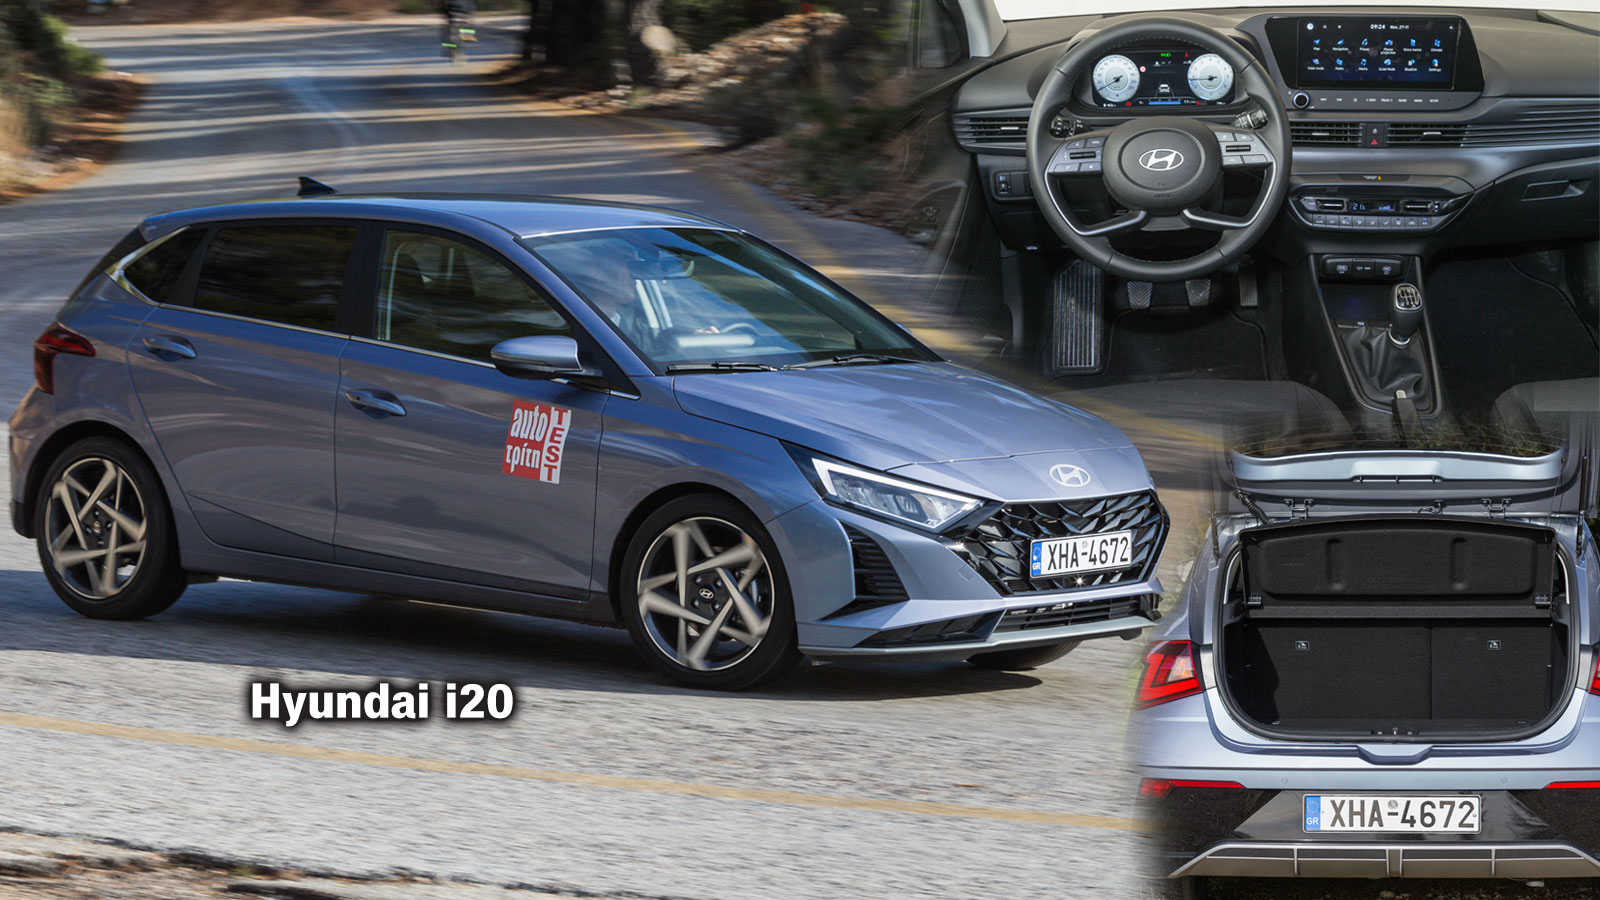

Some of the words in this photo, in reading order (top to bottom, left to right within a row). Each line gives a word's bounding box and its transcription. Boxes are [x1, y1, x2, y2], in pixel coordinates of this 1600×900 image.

[510, 405, 549, 442] auto
[543, 408, 568, 482] TEST
[1032, 562, 1041, 570] GR
[1048, 537, 1129, 570] XHA-4672
[1306, 817, 1319, 825] GR
[1330, 799, 1475, 828] XHA-4672
